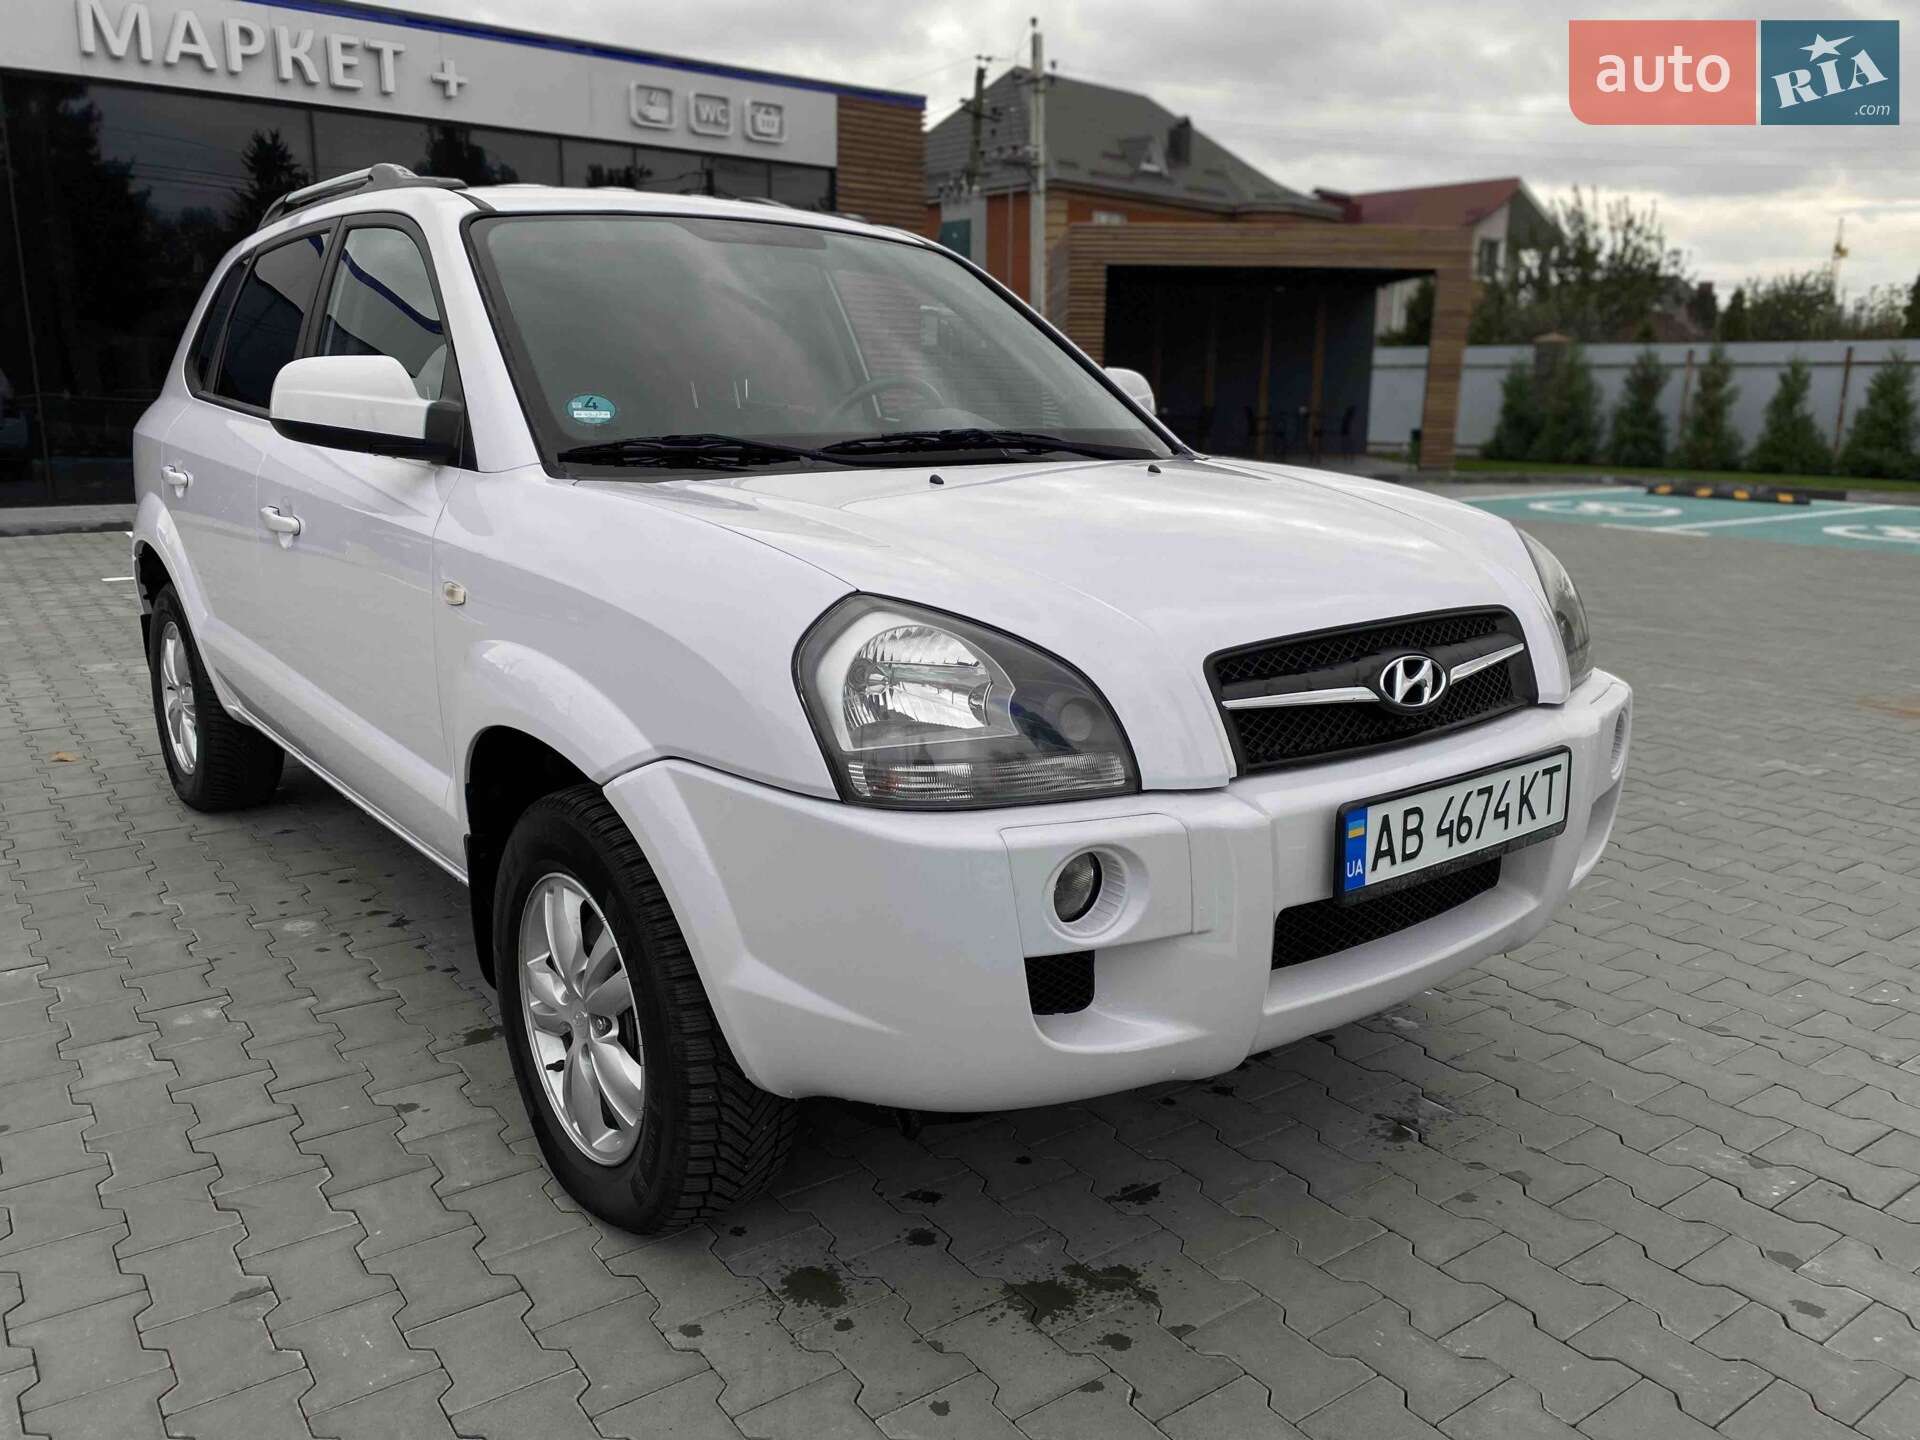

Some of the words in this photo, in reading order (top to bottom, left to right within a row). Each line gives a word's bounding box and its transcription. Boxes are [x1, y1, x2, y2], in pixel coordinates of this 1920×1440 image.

[76, 1, 405, 94] МАРКЕТ
[700, 101, 729, 125] WC
[584, 396, 599, 410] 4
[1370, 806, 1424, 872] AB
[1346, 859, 1364, 878] UA
